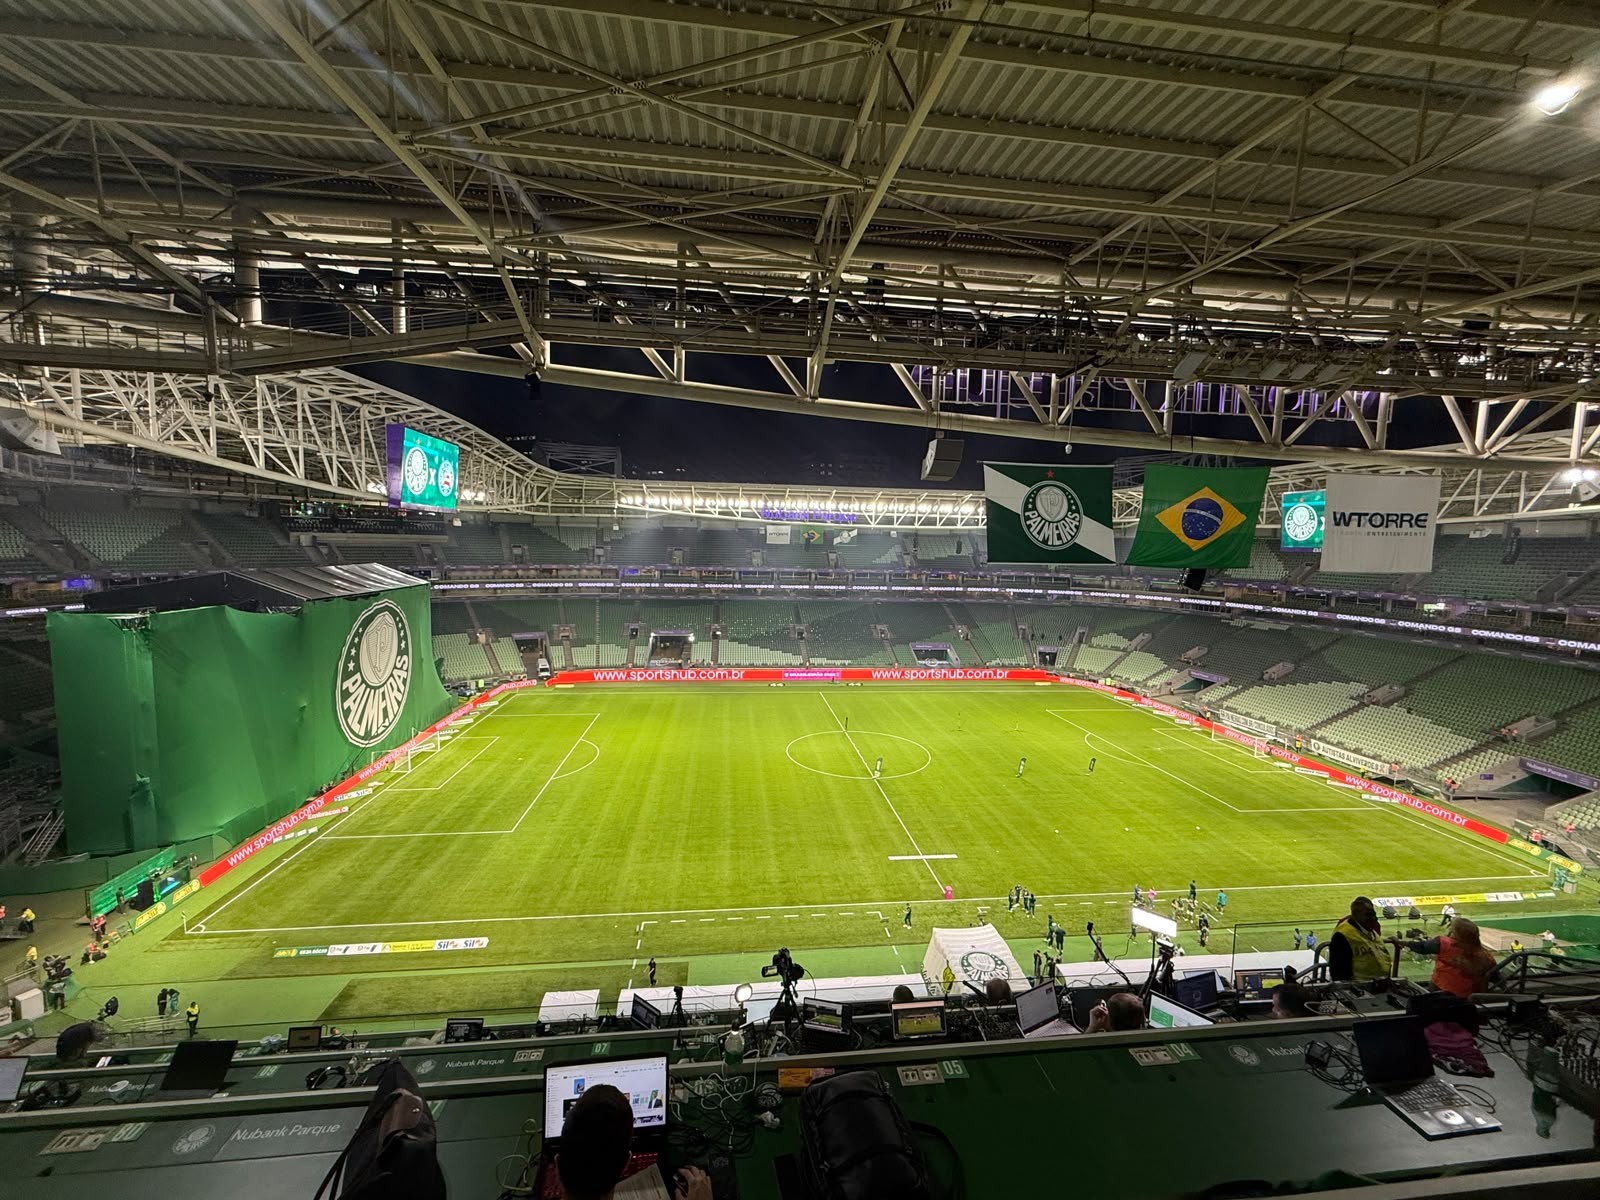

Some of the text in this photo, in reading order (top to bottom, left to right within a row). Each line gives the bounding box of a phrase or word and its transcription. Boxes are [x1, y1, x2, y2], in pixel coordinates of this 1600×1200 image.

[1332, 511, 1429, 529] WTORRE
[1024, 510, 1080, 546] PALMEIRAS
[1397, 620, 1446, 631] COMANDO
[1471, 629, 1523, 641] COMANDO
[593, 670, 746, 681] www.sportshub.com.br
[871, 669, 1009, 680] www.sportshub.com.br
[342, 654, 409, 737] PALMEIRAS
[1321, 745, 1345, 760] AUTISTAS
[1345, 775, 1468, 826] www.sportshub.com.br
[227, 797, 325, 867] www.sportshub.com.br
[437, 941, 449, 949] Sil
[463, 940, 475, 948] Sil
[594, 1043, 608, 1053] 07
[1169, 1042, 1195, 1057] 04
[259, 1065, 278, 1076] 09
[445, 1057, 505, 1069] Nubank Parque
[942, 1060, 964, 1075] 05
[229, 1126, 288, 1141] Nubank
[289, 1122, 341, 1137] Parque
